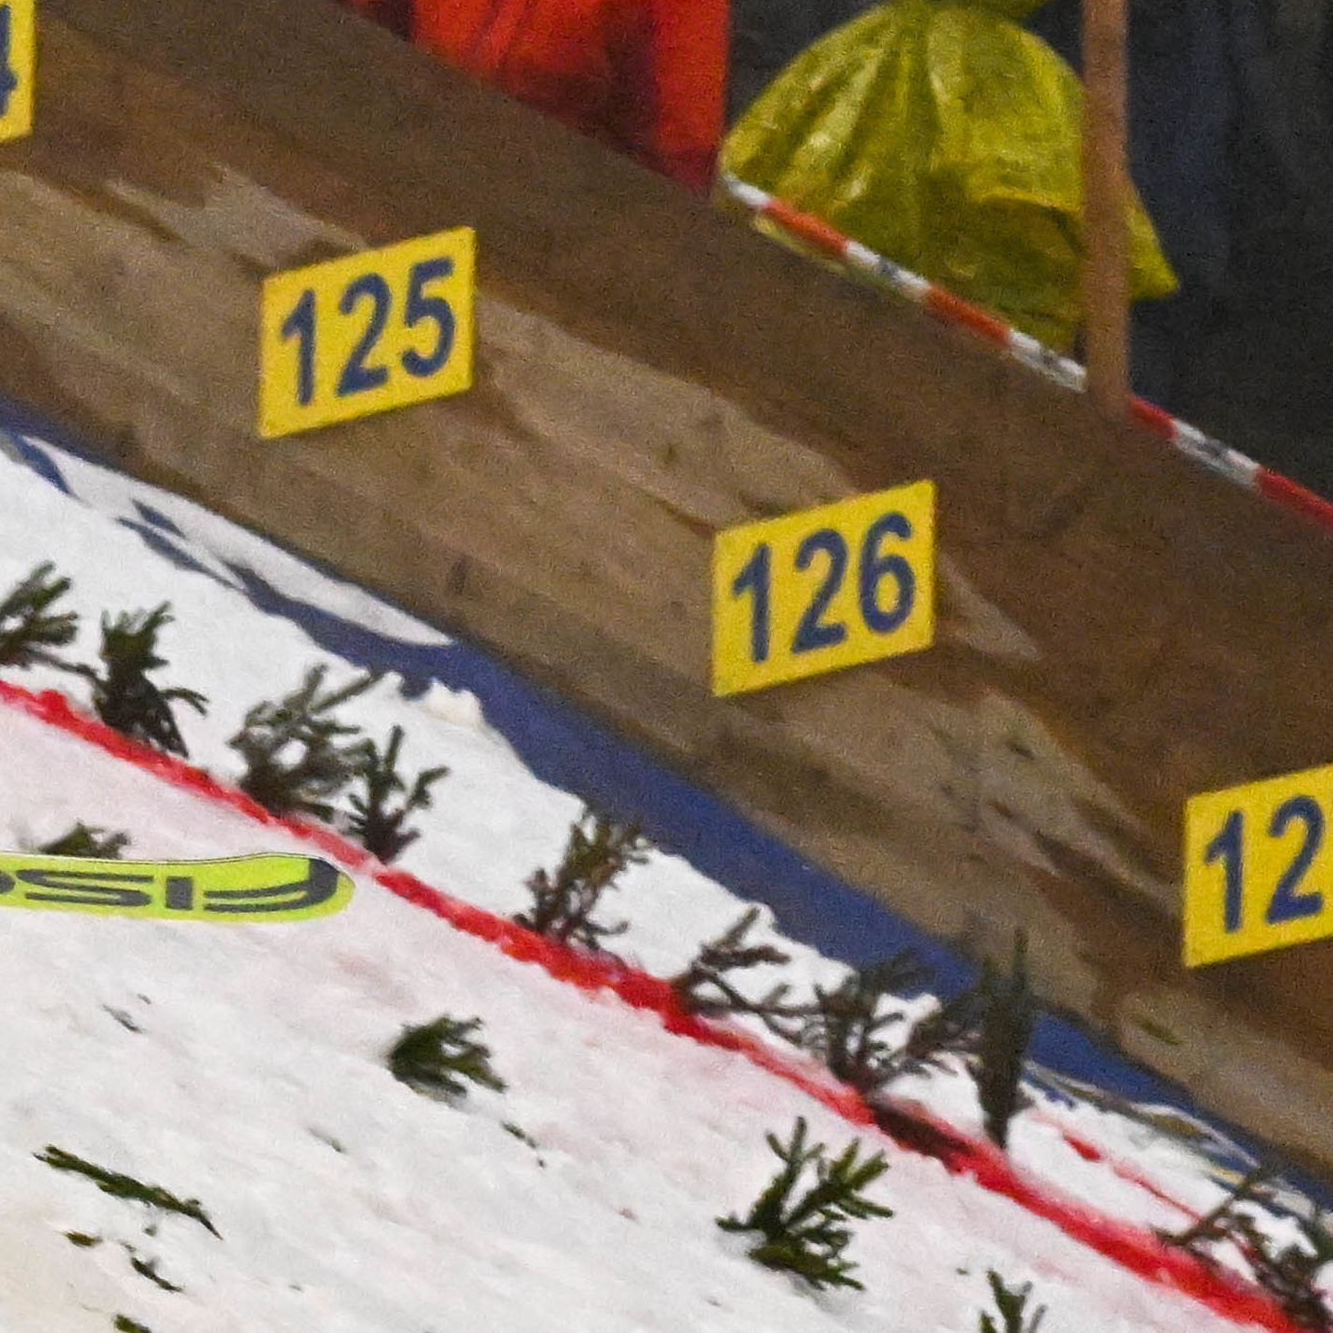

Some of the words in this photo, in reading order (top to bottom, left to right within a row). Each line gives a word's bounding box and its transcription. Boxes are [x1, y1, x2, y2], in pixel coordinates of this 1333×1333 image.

[282, 257, 454, 405] 125
[733, 513, 914, 663] 126
[1205, 795, 1326, 933] 12
